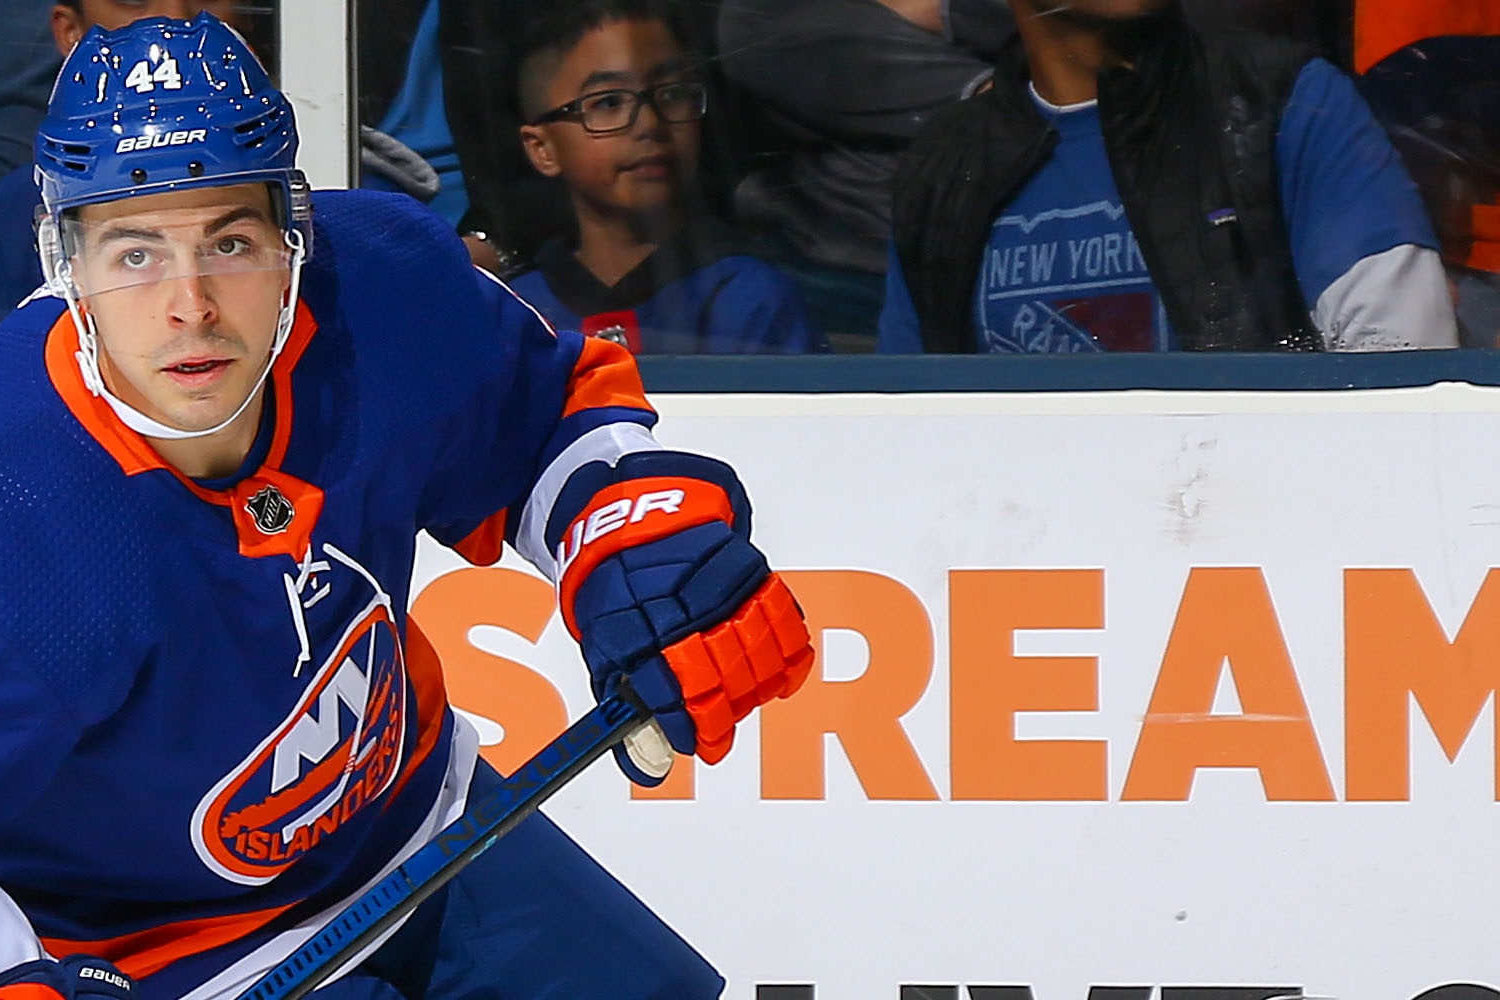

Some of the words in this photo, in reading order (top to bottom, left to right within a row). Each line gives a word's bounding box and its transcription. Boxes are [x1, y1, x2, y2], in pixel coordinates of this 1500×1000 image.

[125, 58, 182, 93] 44
[990, 242, 1057, 288] NEW
[410, 566, 1500, 802] SREAM
[235, 708, 398, 861] ISLANDERS
[436, 722, 602, 857] NEXUS
